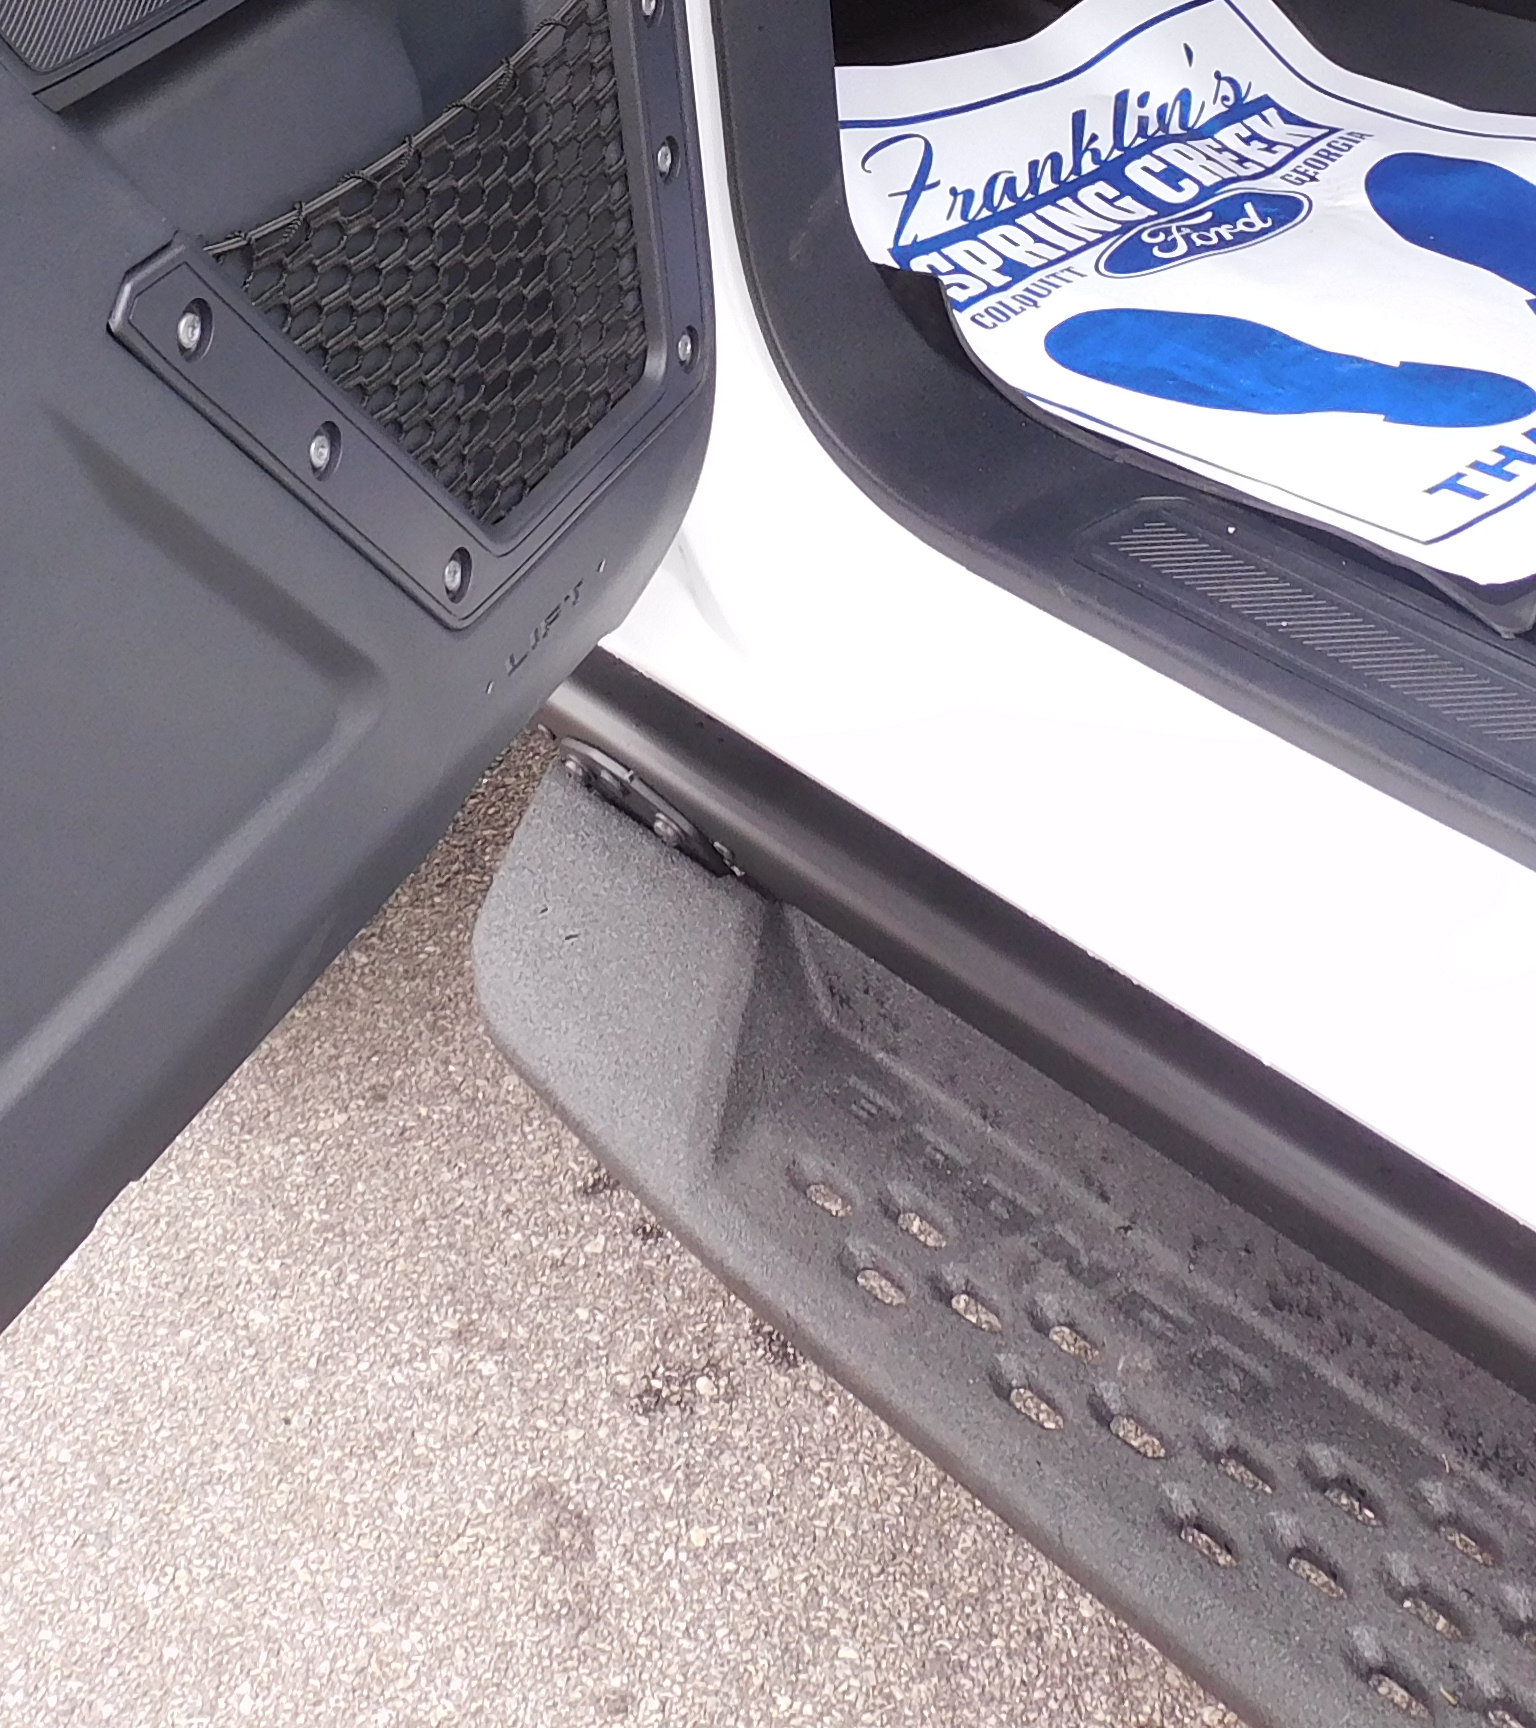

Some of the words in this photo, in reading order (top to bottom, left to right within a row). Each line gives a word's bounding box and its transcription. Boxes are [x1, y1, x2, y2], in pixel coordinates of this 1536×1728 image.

[861, 43, 1252, 249] Franklin's
[909, 183, 1158, 304] SPRING
[1125, 107, 1329, 205] CREEK
[970, 265, 1088, 330] COLQUITT
[1141, 202, 1272, 259] Ford
[1279, 129, 1376, 186] GEORGIA
